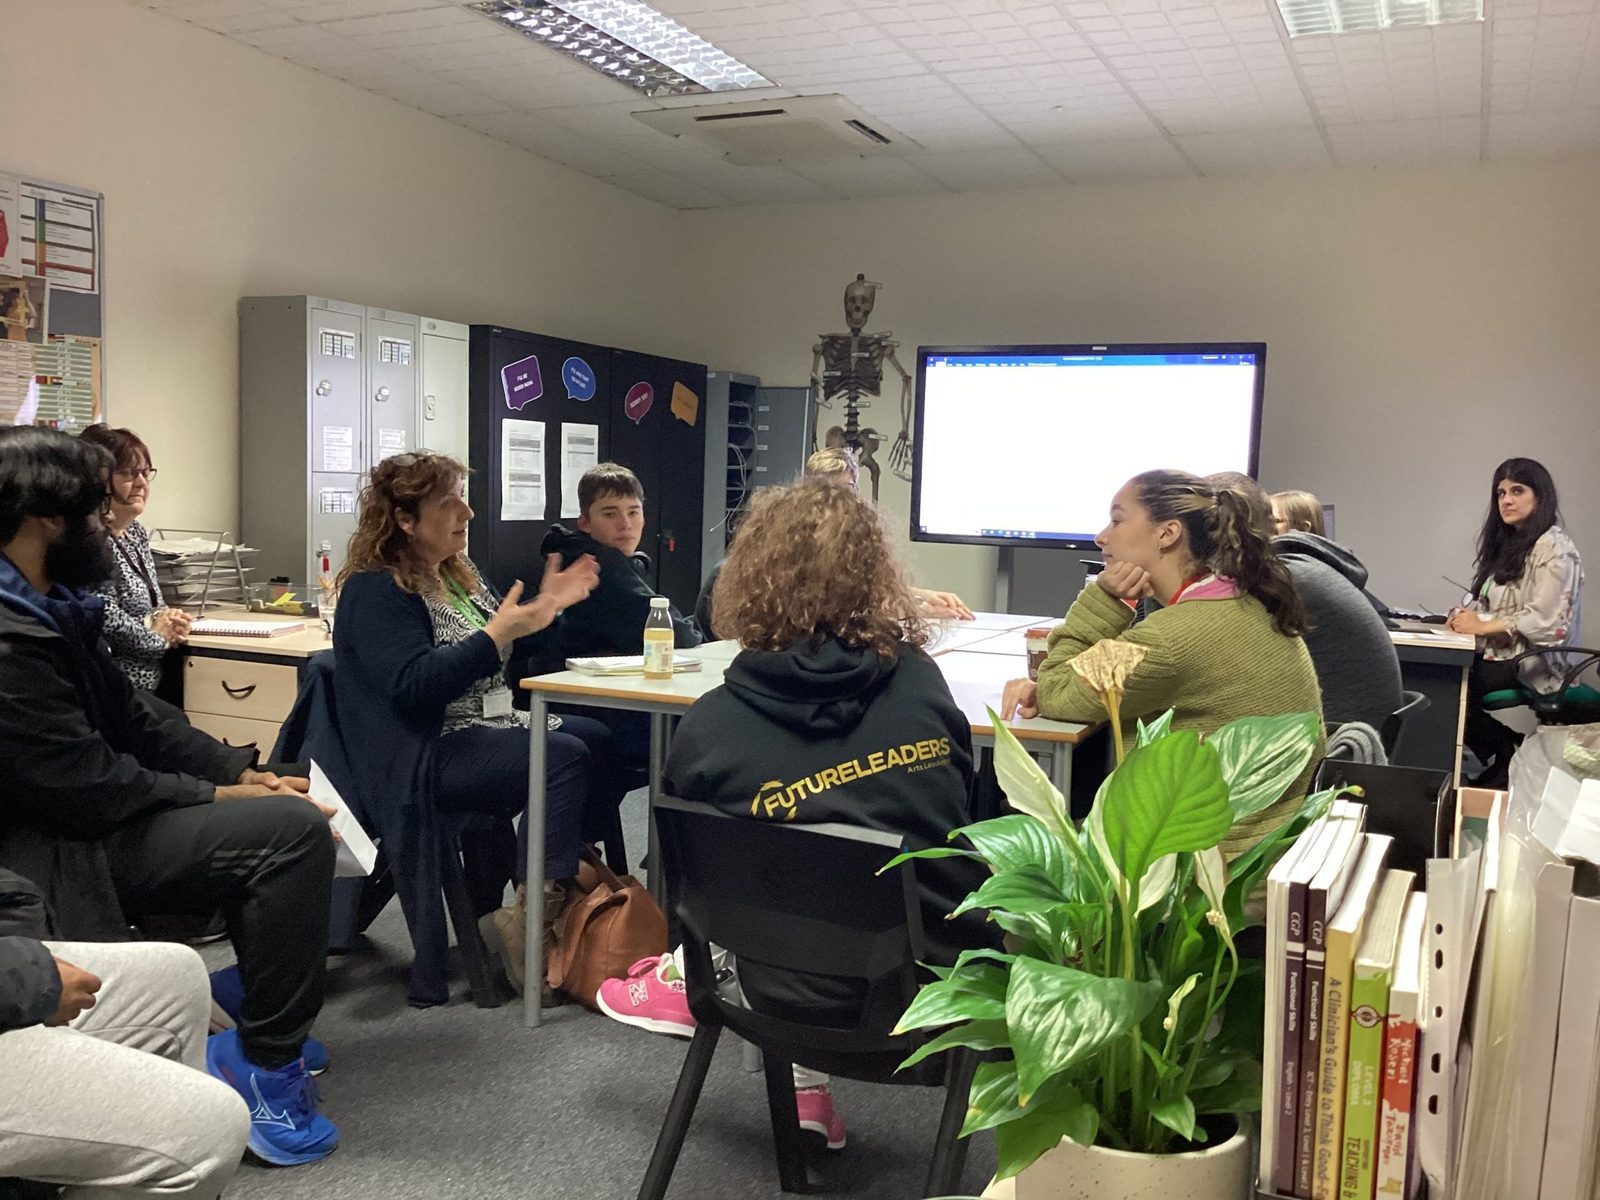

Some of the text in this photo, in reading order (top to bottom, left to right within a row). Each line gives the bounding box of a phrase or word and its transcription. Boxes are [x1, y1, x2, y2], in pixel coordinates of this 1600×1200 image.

[763, 737, 950, 818] FUTURELEADERS
[907, 764, 924, 774] Arts
[1290, 911, 1301, 936] CGP
[1312, 920, 1323, 945] CGP
[1329, 977, 1341, 987] A
[1288, 972, 1298, 1031] Functional Skills
[1311, 981, 1319, 1019] Functional
[1325, 990, 1342, 1054] Clinician's
[1285, 1060, 1294, 1085] English
[1387, 1037, 1401, 1080] Rosen
[1398, 1039, 1411, 1084] Michael
[1305, 1070, 1314, 1083] ICT
[1323, 1057, 1337, 1093] Guide
[1351, 1061, 1361, 1105] DIPLOMA
[1362, 1065, 1374, 1095] LEVEL
[1285, 1092, 1293, 1109] Level
[1303, 1090, 1313, 1107] Entry
[1321, 1097, 1333, 1110] to
[1302, 1135, 1310, 1152] Level
[1320, 1113, 1334, 1144] Think
[1393, 1124, 1406, 1157] David
[1300, 1166, 1308, 1184] Level
[1343, 1137, 1361, 1199] TEACHING &
